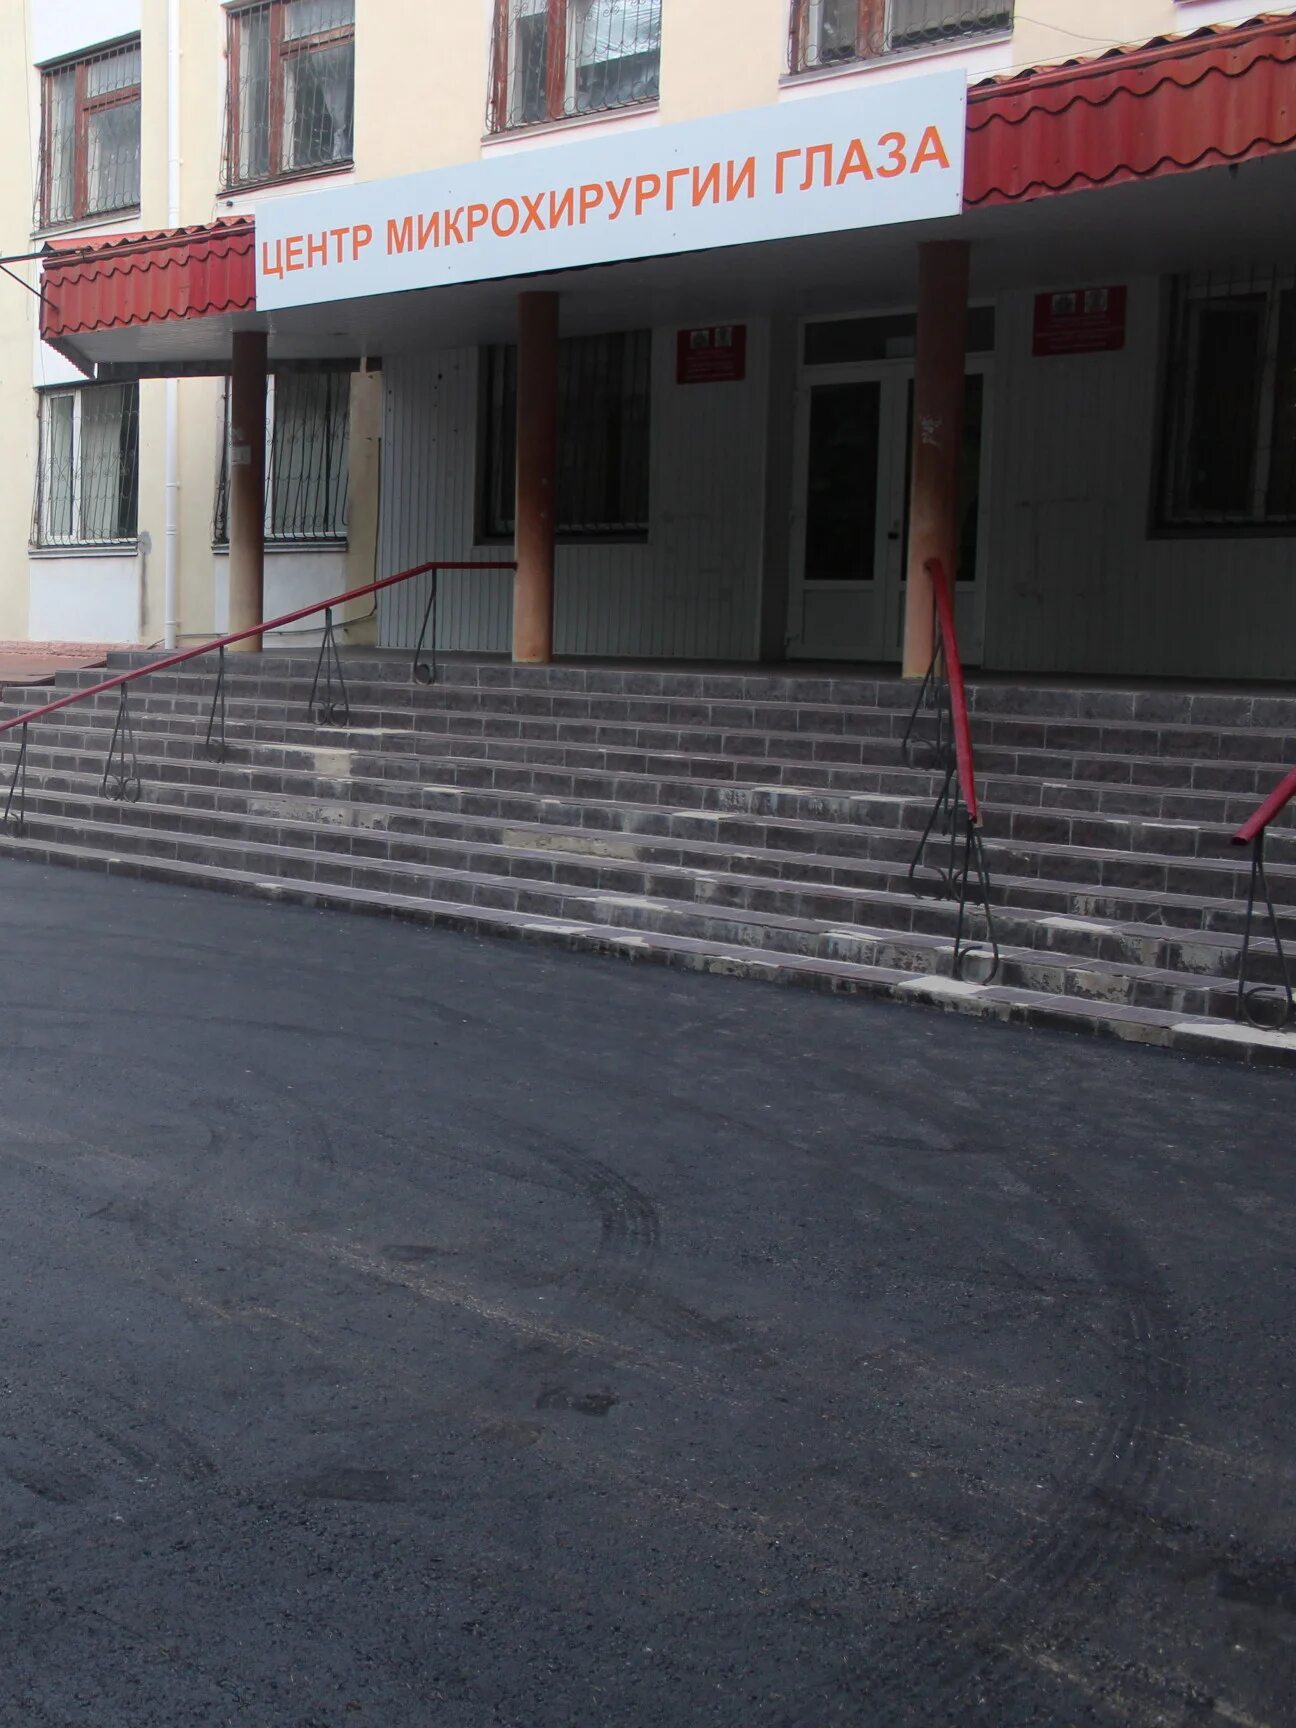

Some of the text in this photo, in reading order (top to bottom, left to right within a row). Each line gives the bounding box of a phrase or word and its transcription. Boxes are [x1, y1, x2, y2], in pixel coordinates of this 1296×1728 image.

[261, 125, 951, 279] ЦЕНТР МИКРОХИРУРГИИ ГЛАЗА
